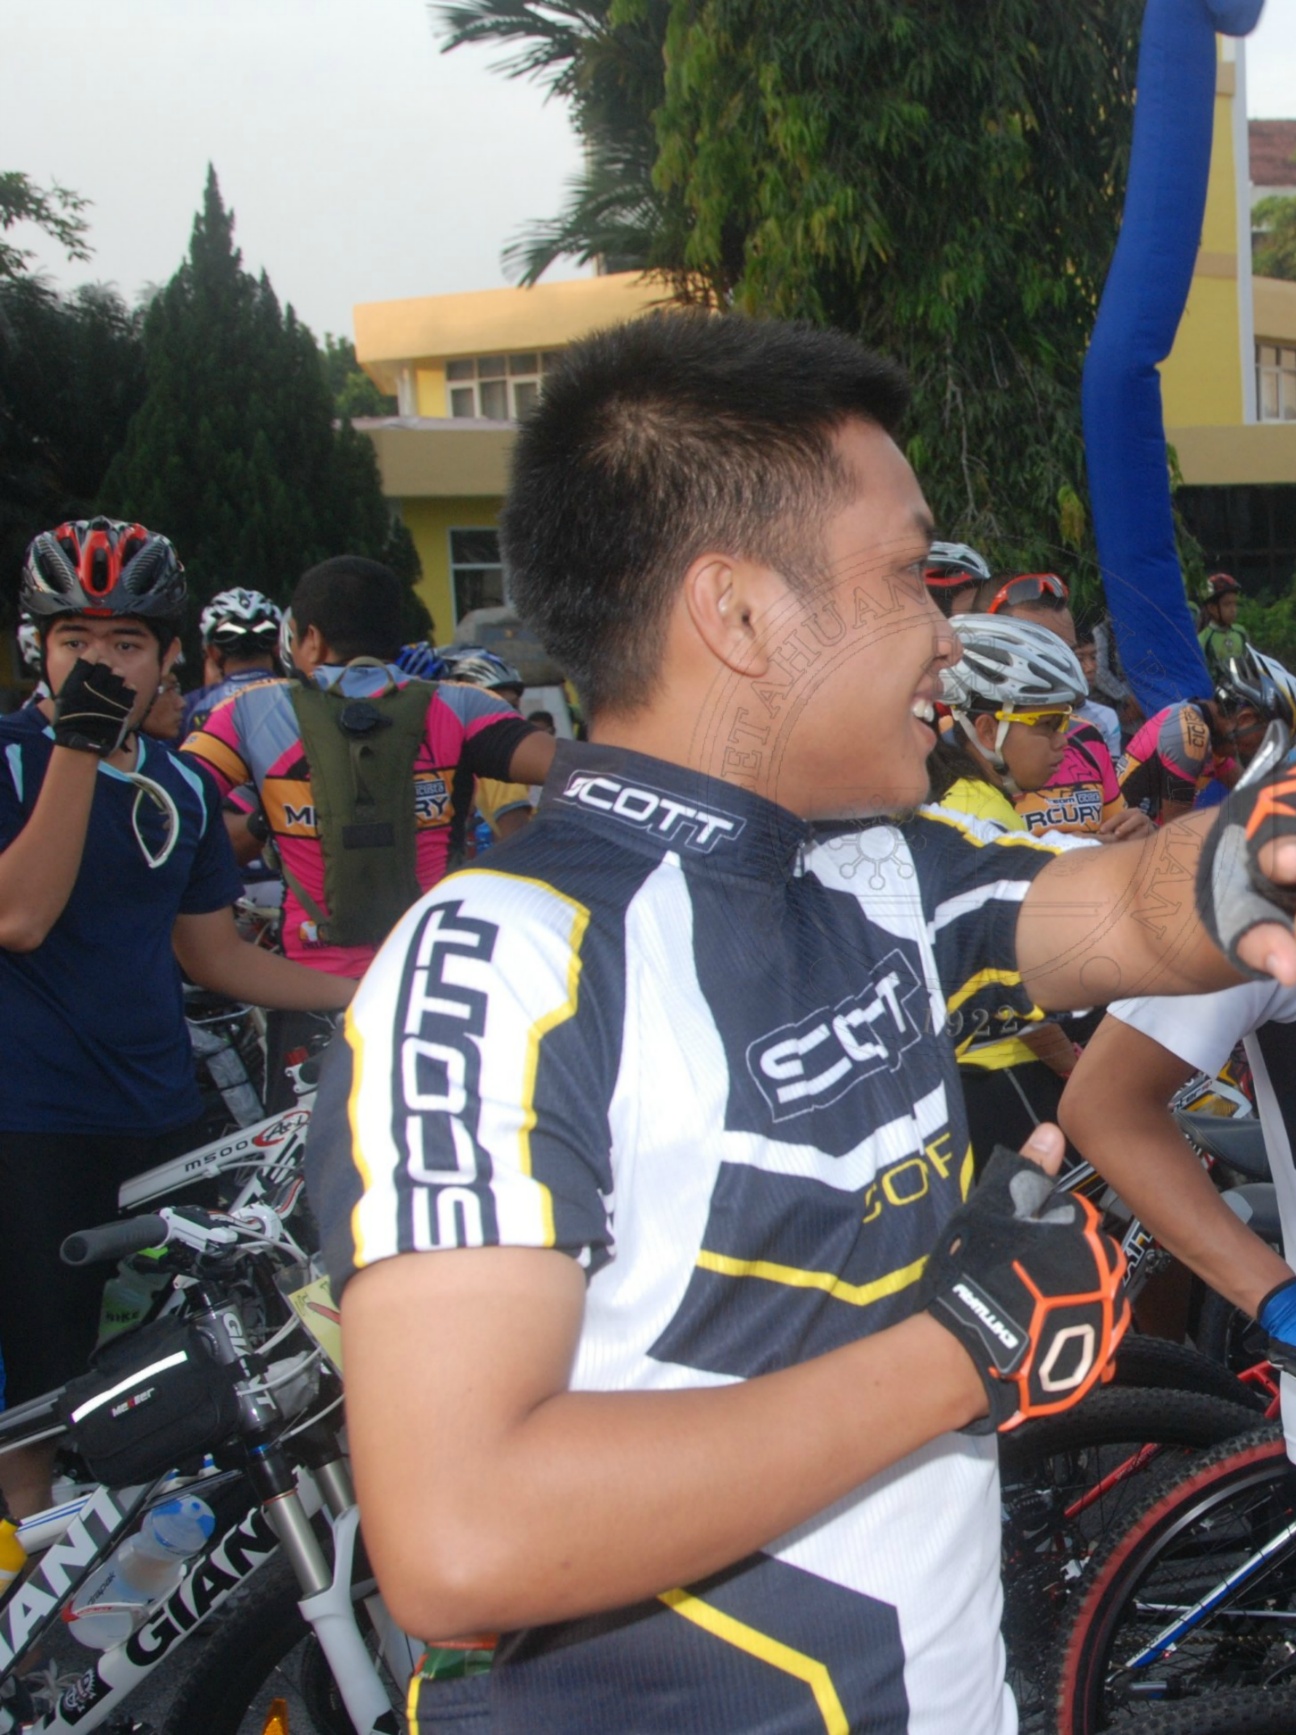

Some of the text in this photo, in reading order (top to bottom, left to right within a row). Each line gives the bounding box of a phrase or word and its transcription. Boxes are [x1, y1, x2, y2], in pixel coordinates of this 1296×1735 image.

[563, 777, 734, 844] SCOTT
[400, 902, 490, 1254] SCOTT
[126, 1508, 282, 1667] GIAN
